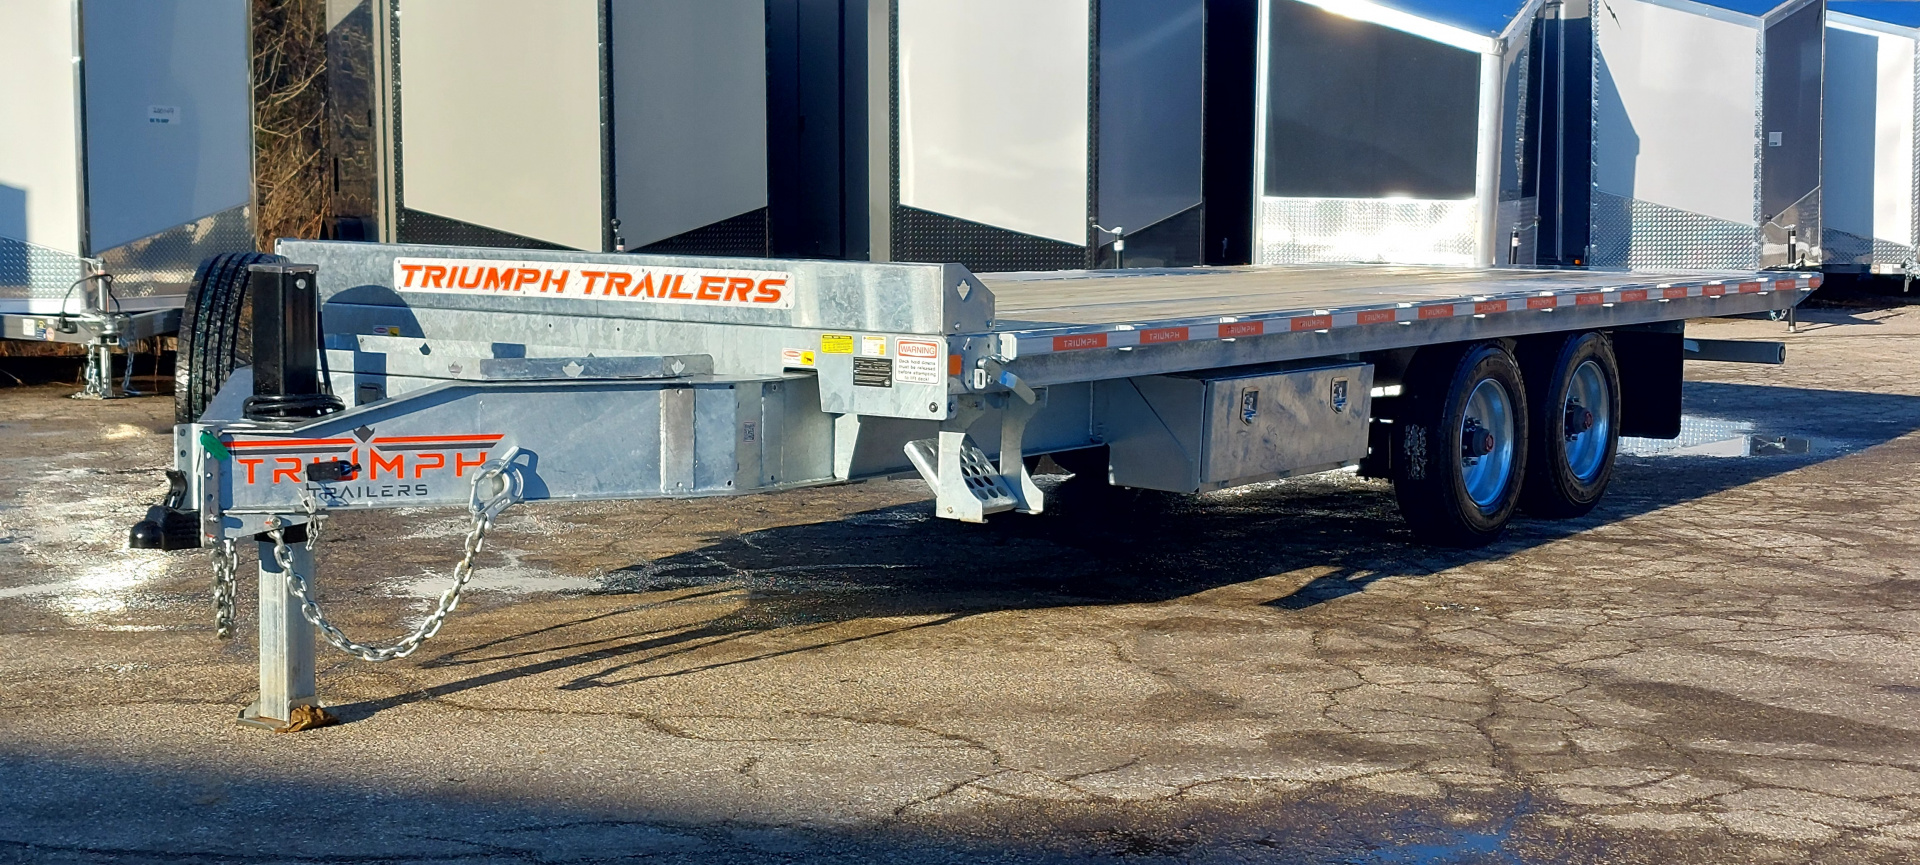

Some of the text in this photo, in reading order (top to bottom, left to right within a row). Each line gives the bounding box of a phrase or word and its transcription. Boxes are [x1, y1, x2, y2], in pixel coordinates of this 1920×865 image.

[401, 264, 787, 303] TRIUMPH TRAILERS
[1364, 313, 1389, 321] TRIUMPH
[1300, 319, 1325, 328] TRIUMPH
[1226, 325, 1256, 334] TRIUMPH
[1149, 331, 1180, 341] TRIUMPH
[1063, 338, 1098, 348] TRIUMPH
[901, 345, 934, 354] WARNING
[238, 447, 488, 484] TRUMPH
[307, 484, 428, 500] TRAILERS
